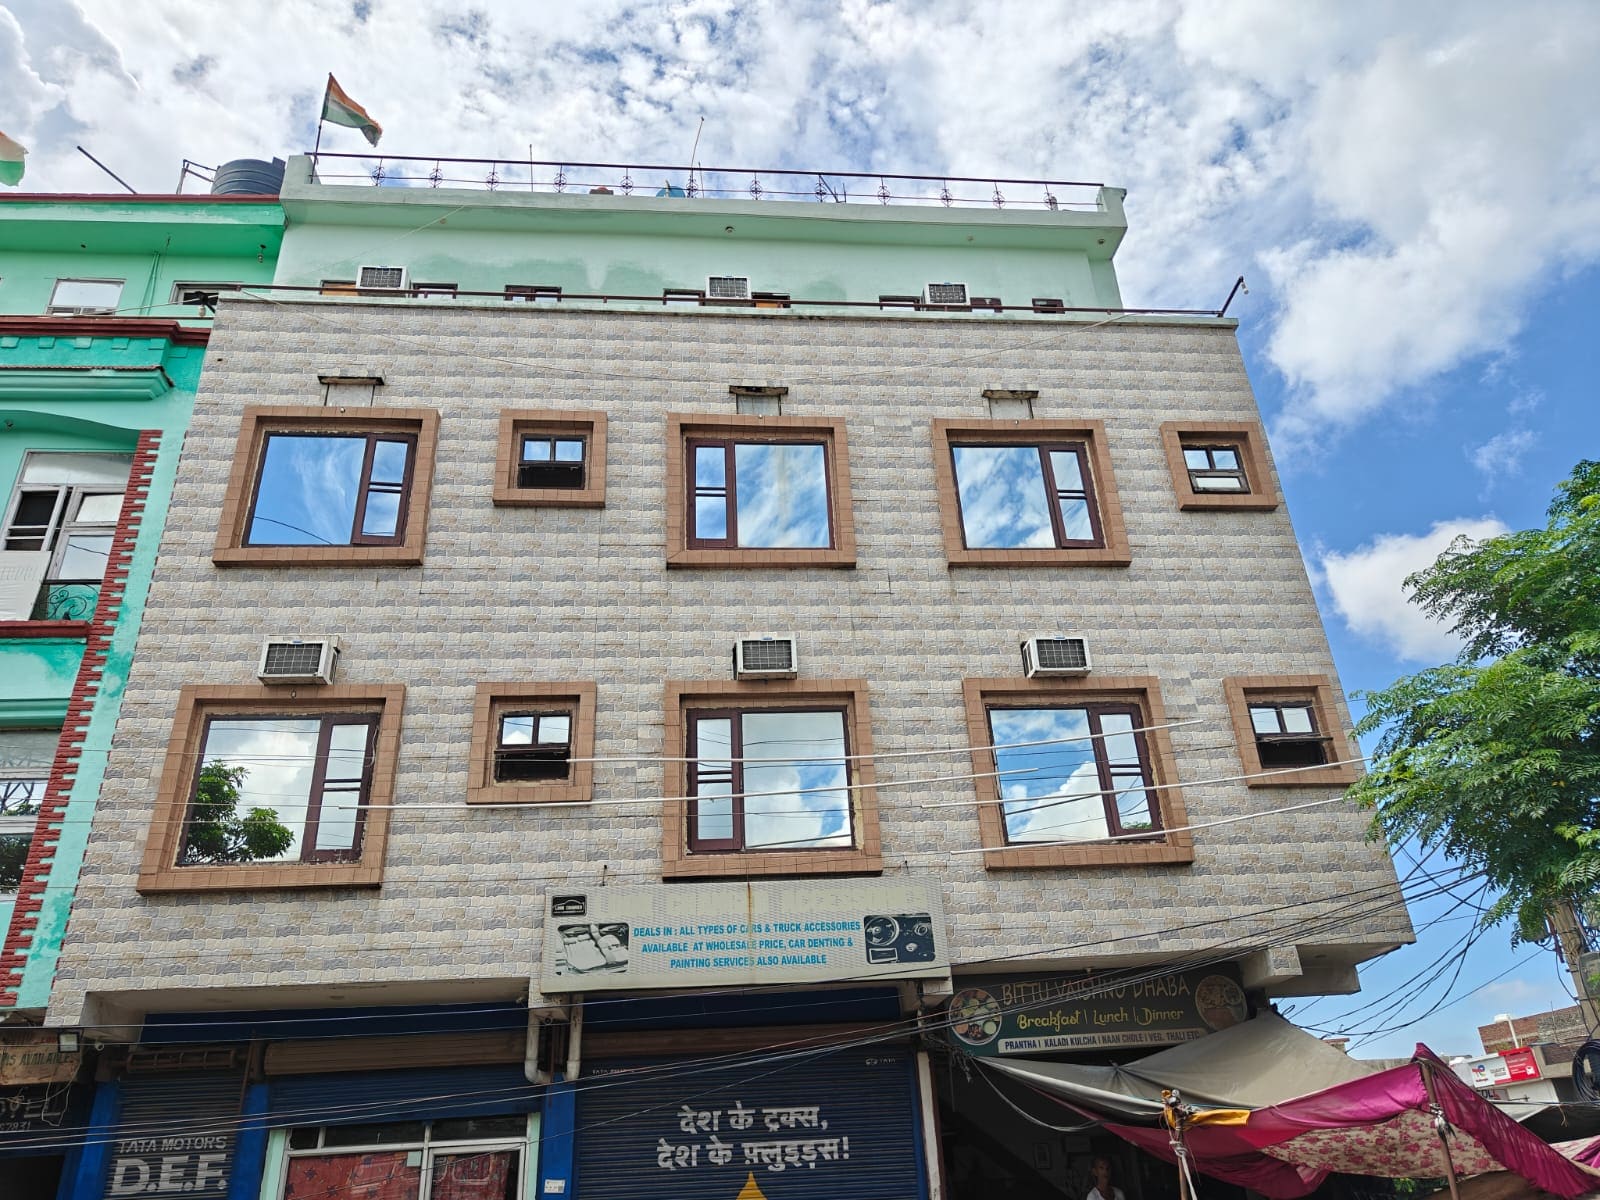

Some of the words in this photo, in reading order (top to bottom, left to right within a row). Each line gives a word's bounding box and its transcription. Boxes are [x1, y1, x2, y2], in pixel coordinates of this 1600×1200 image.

[633, 927, 660, 937] DEALS
[663, 926, 673, 936] IN
[679, 926, 695, 935] ALL
[697, 925, 725, 935] TYPES
[726, 924, 738, 934] OF
[764, 923, 771, 932] &
[773, 922, 801, 933] TRUCK
[804, 921, 861, 932] ACCESSORIES
[642, 942, 688, 953] AVAILABLE
[692, 942, 704, 951] AT
[705, 940, 757, 951] WHOLESALE
[759, 939, 787, 950] PRICE,
[788, 939, 806, 949] CAR
[808, 937, 843, 948] DENTING
[847, 937, 853, 947] &
[670, 958, 711, 968] PAINTING
[713, 957, 755, 968] SERVICES
[757, 956, 779, 966] ALSO
[781, 954, 827, 965] AVAILABLE
[1002, 981, 1049, 1005] BITTU
[1132, 975, 1190, 998] DHABA
[1016, 1010, 1081, 1032] Breakfast
[1093, 1006, 1128, 1026] Lunch
[1136, 1007, 1184, 1026] Dinner
[1005, 1040, 1037, 1050] PRANTHA
[1044, 1038, 1069, 1048] KALADI
[1070, 1036, 1097, 1046] KULCHA
[1102, 1035, 1121, 1045] NAAN
[1121, 1034, 1144, 1043] CHOLE
[1166, 1032, 1186, 1041] THALI
[677, 1105, 721, 1134] देश
[728, 1100, 755, 1129] के
[118, 1139, 157, 1153] TATA
[161, 1136, 227, 1151] MOTORS
[656, 1137, 701, 1170] देश
[705, 1135, 734, 1165] के
[110, 1153, 228, 1195] D.E.F.
